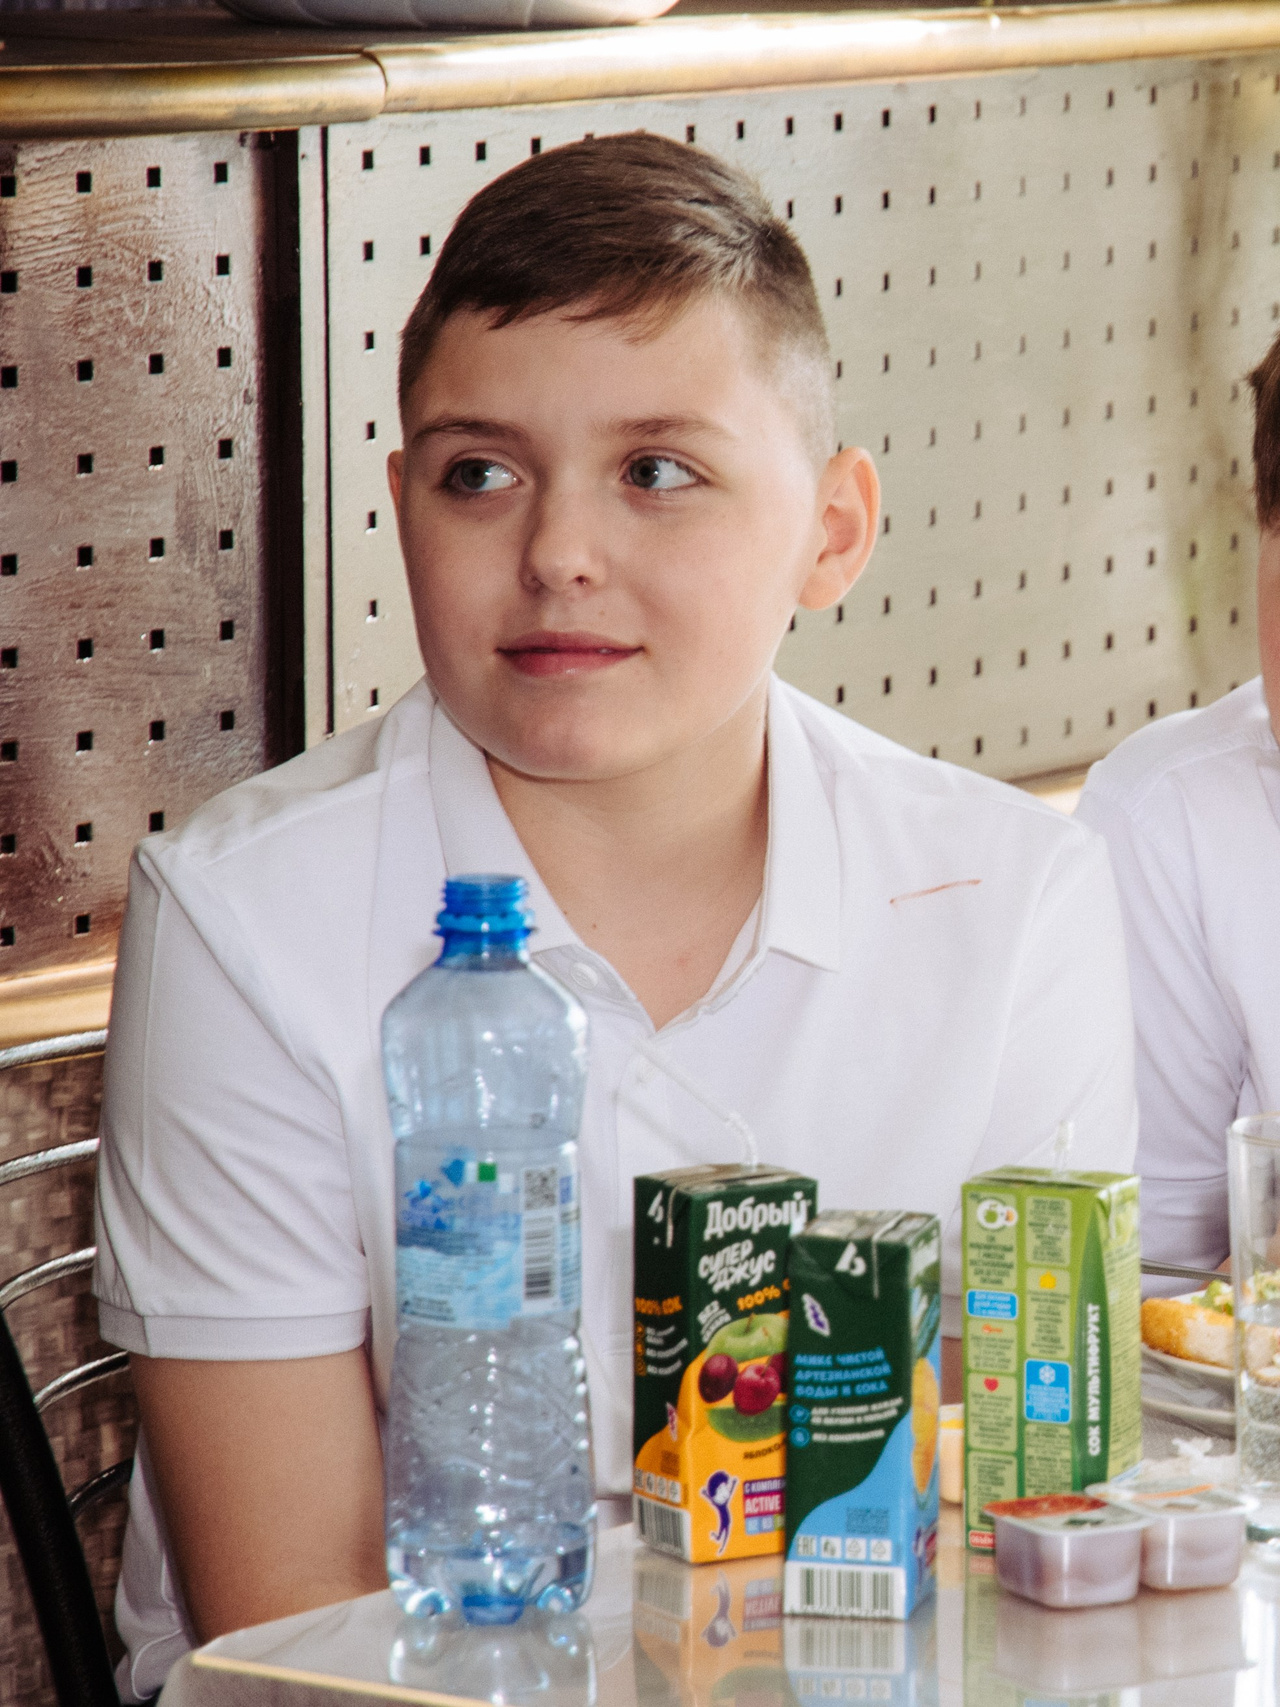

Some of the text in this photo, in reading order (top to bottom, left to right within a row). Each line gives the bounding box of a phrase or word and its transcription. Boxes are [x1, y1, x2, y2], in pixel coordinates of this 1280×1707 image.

[703, 1191, 807, 1241] Добрый
[698, 1239, 753, 1285] СУПЕР
[711, 1249, 776, 1293] ДЖУС
[736, 1284, 782, 1312] 100%
[854, 1380, 888, 1396] СОКА
[1087, 1302, 1101, 1457] СОК МУЛЬТИФРУКТ
[744, 1494, 781, 1514] ACTIVE
